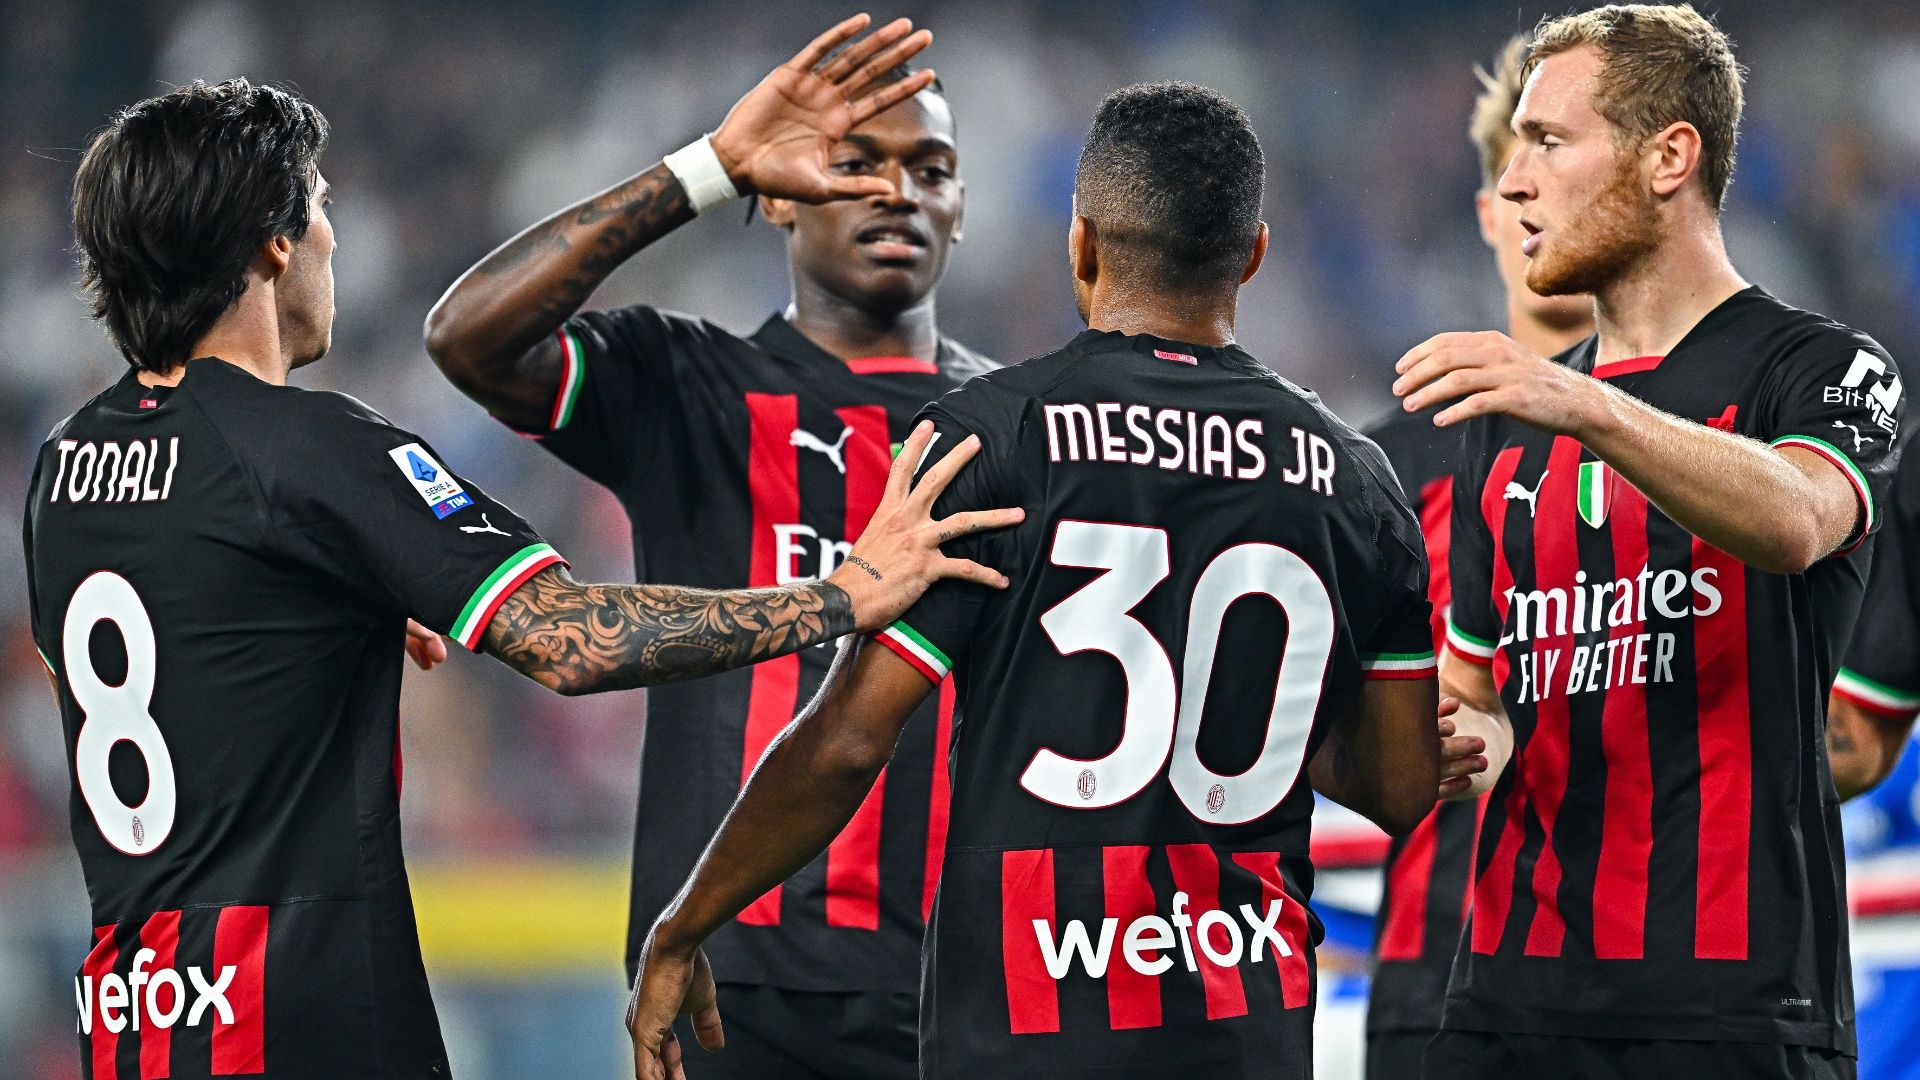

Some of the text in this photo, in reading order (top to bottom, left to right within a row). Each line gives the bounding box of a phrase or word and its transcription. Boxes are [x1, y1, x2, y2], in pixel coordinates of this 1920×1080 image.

[49, 436, 179, 502] TONALI
[425, 481, 452, 496] SERIE A
[1044, 402, 1336, 496] MESSIAS JR
[446, 496, 468, 508] TIM
[1019, 519, 1335, 825] 30
[1517, 632, 1676, 704] FLY BETTER
[63, 569, 176, 856] 8
[1032, 891, 1292, 979] wefox
